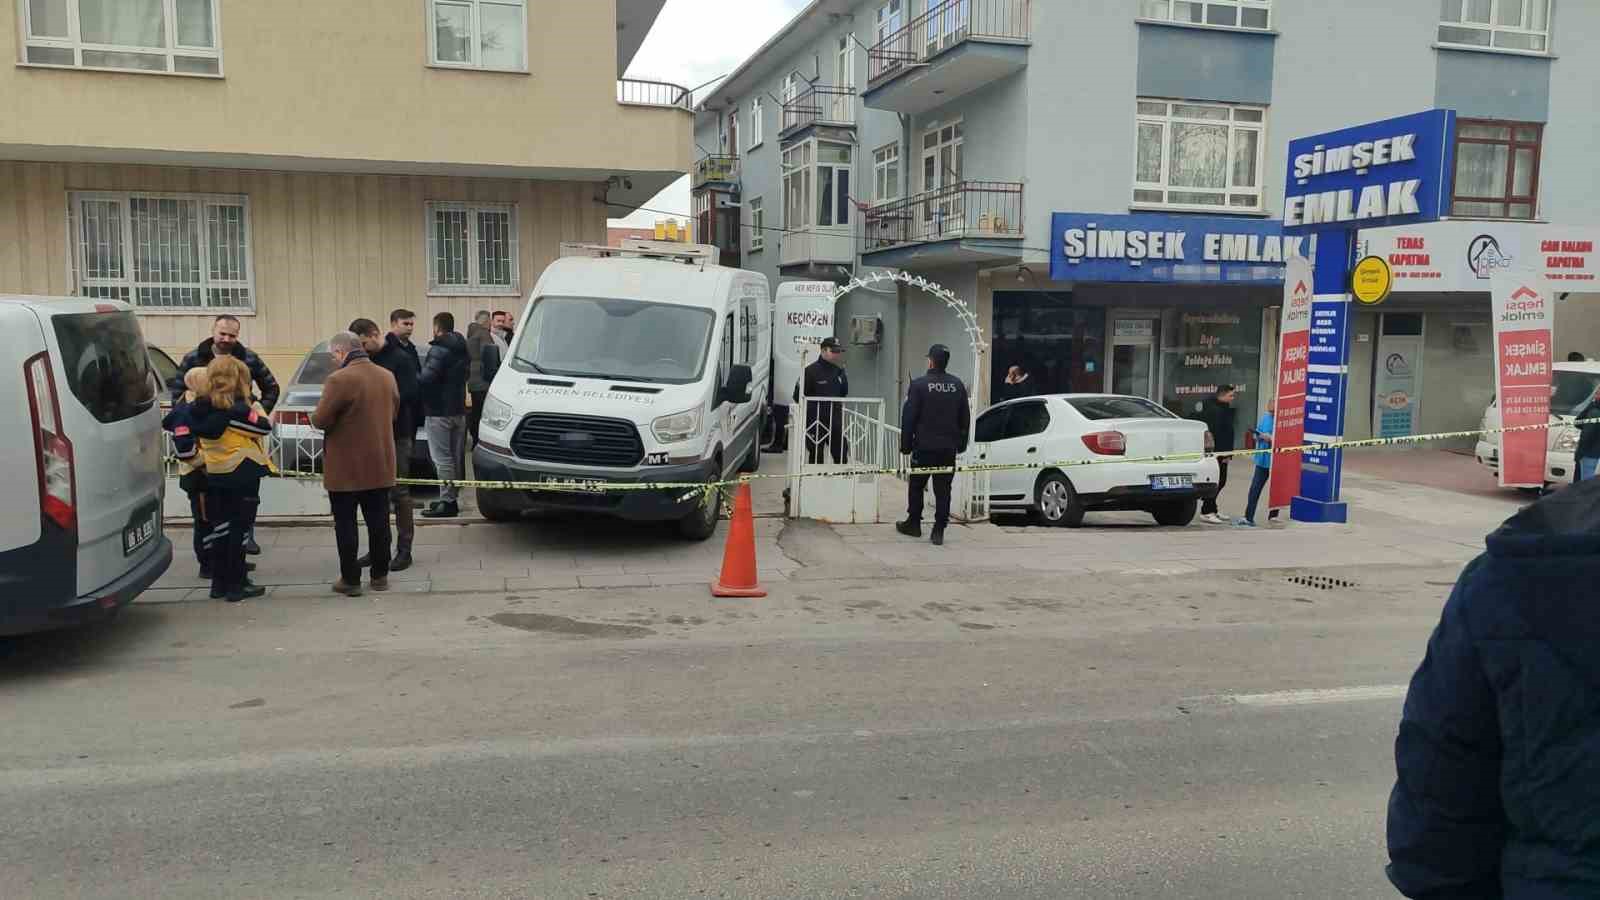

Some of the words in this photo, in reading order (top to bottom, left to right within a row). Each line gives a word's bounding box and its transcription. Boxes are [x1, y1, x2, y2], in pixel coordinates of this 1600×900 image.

[1294, 133, 1416, 185] ŞİMŞEK
[1284, 178, 1421, 227] EMLAK
[1063, 222, 1186, 266] ŞİMŞEK
[1203, 233, 1303, 263] EMLAK
[648, 454, 669, 464] M1
